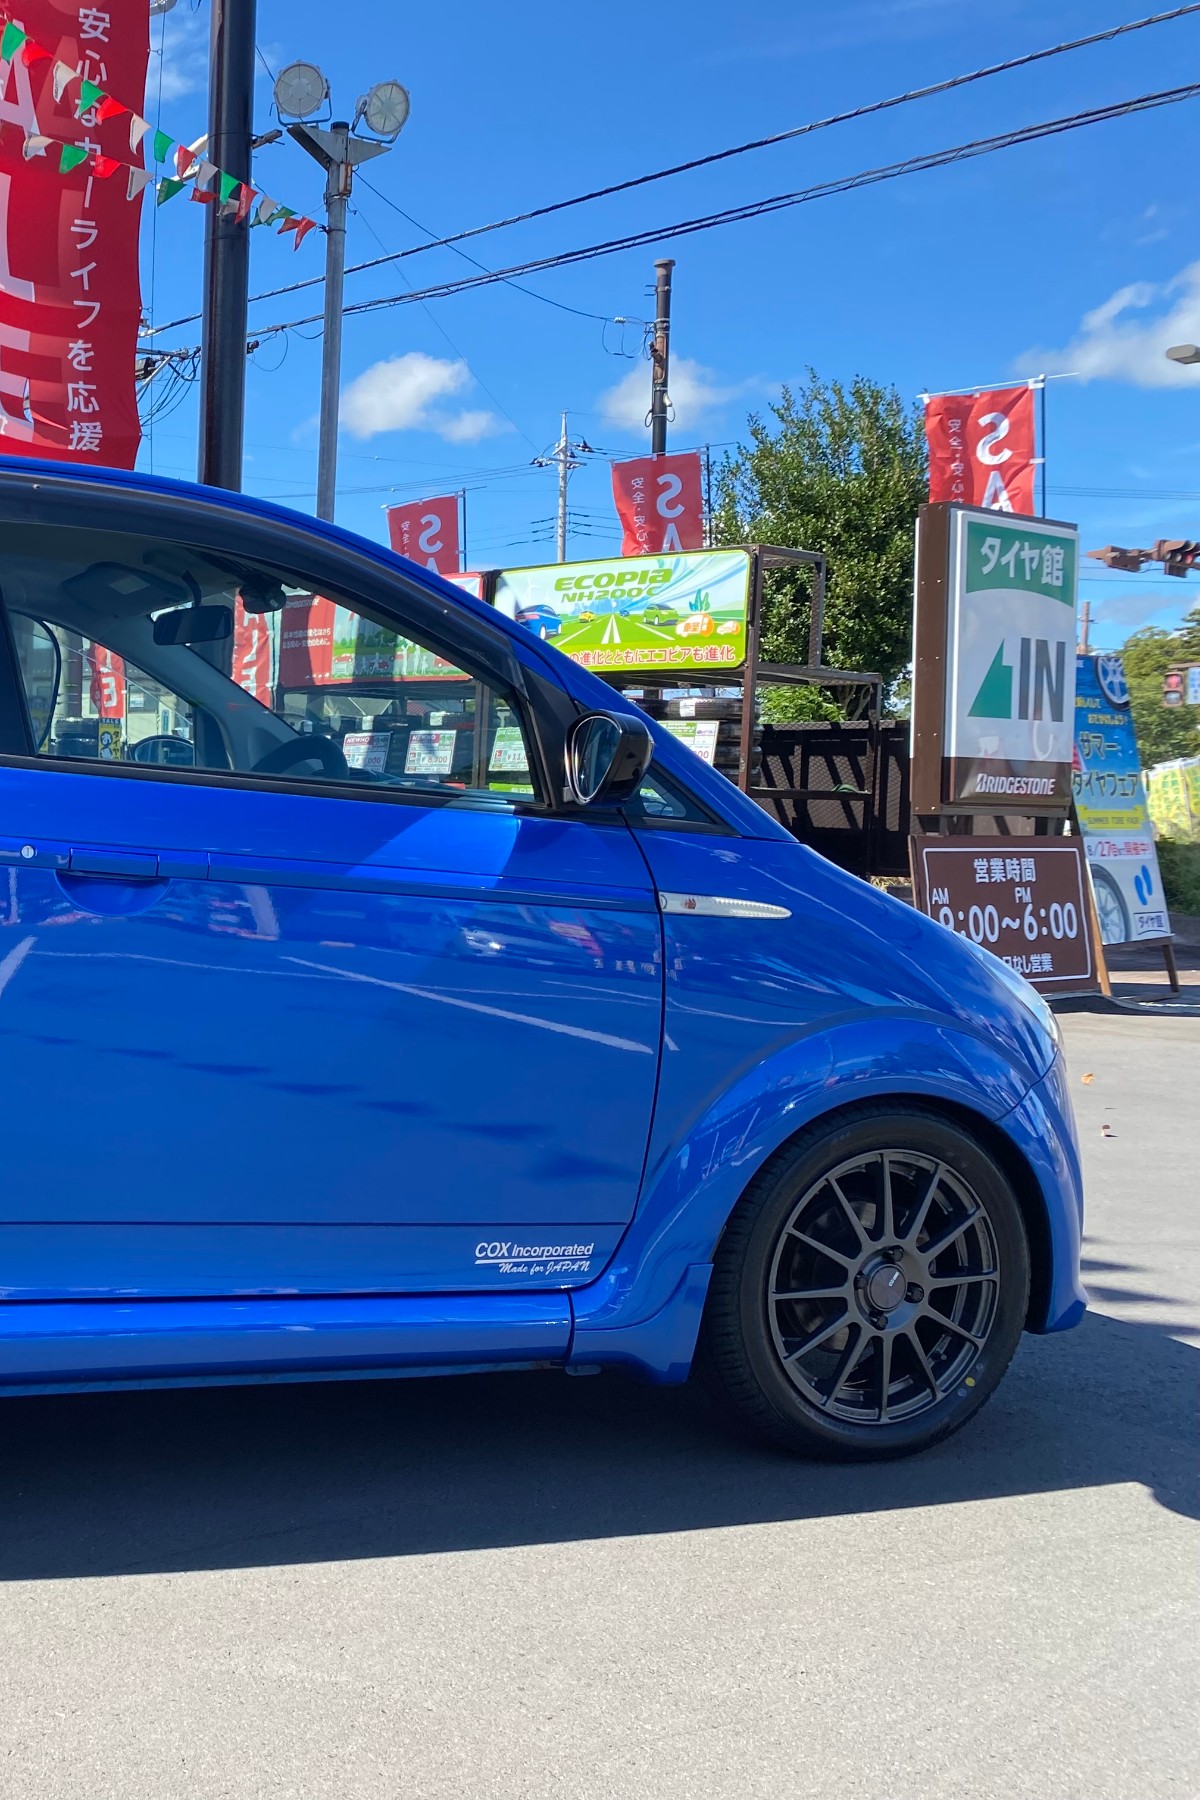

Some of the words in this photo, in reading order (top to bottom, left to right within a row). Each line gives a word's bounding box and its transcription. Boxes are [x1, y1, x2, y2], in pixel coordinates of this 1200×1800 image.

[980, 536, 1065, 587] タイヤ館
[1018, 637, 1066, 723] IN
[1079, 731, 1121, 760] サマー
[975, 773, 1056, 795] BRIDGESTONE
[973, 858, 1036, 884] 営業時間
[931, 887, 950, 905] AM
[1014, 886, 1032, 904] PM
[475, 1242, 512, 1258] COX
[512, 1243, 595, 1259] Incorporated
[498, 1262, 529, 1274] Made
[529, 1263, 545, 1276] for
[545, 1260, 590, 1276] JAPAN
